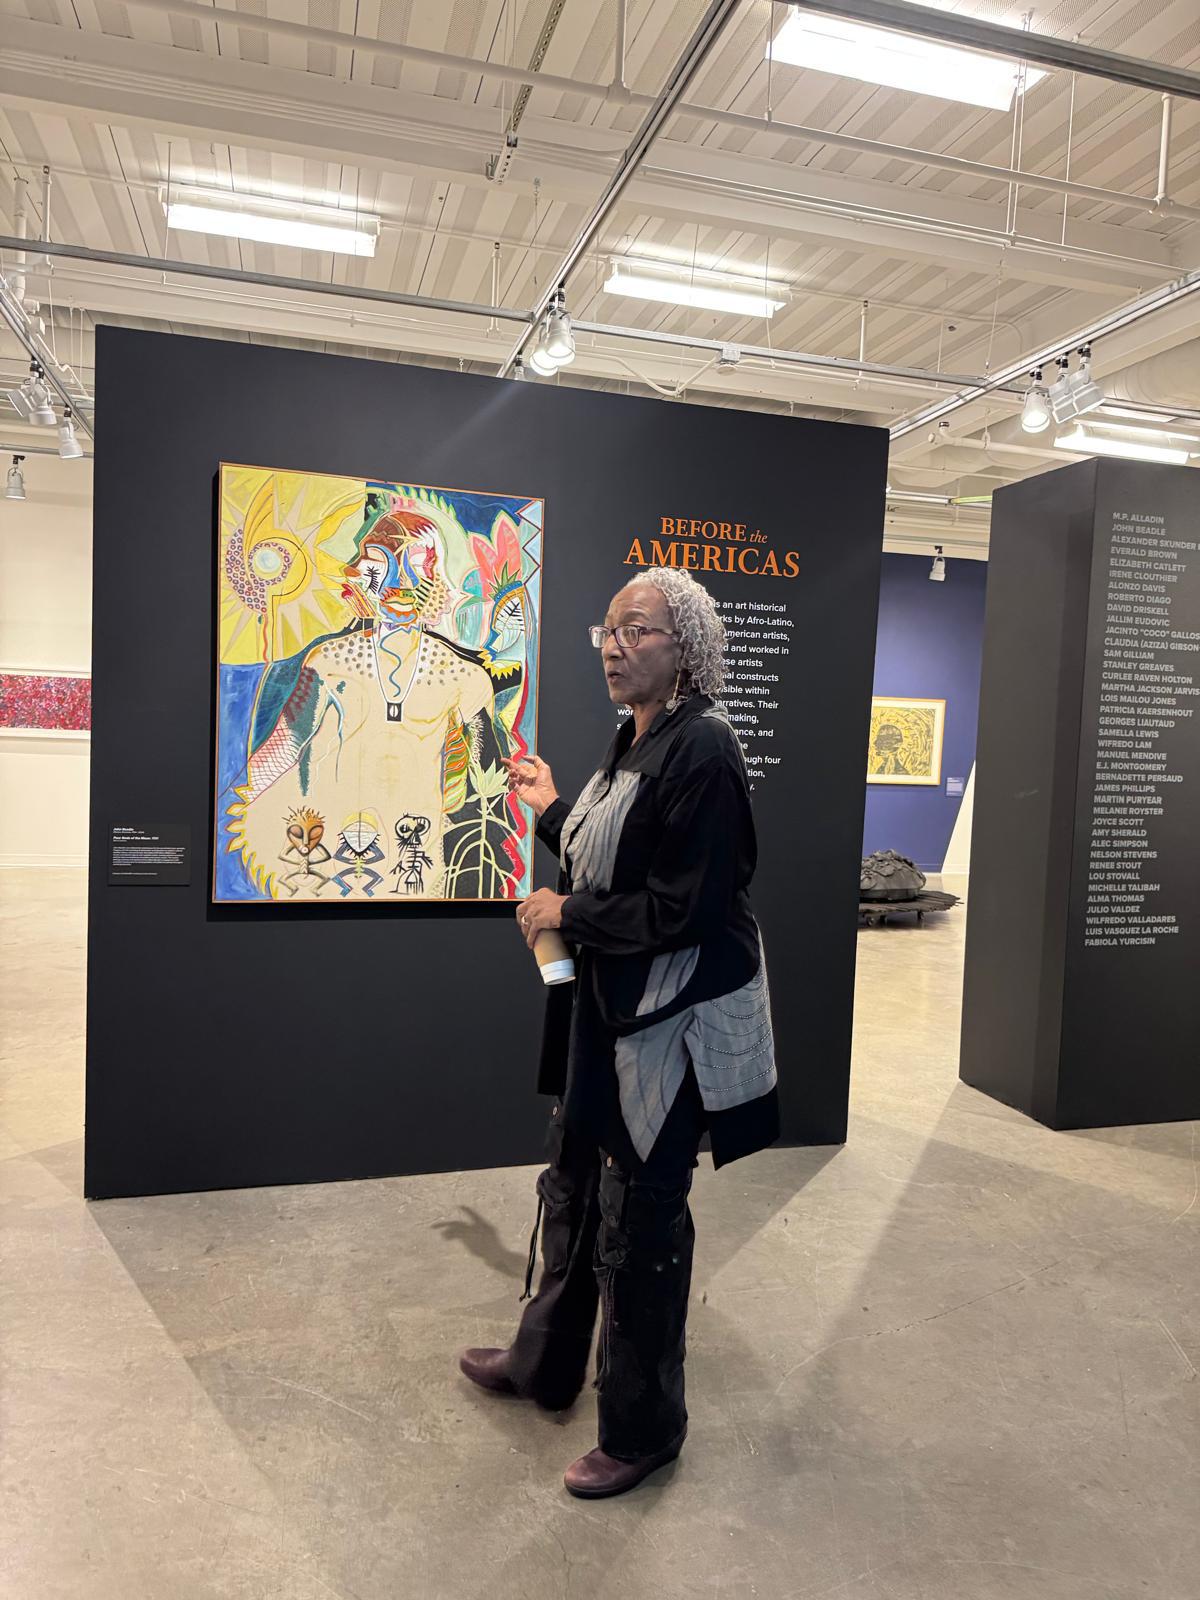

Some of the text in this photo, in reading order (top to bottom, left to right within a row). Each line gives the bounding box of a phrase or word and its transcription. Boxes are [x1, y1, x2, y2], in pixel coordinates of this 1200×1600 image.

[1130, 514, 1164, 524] ALLADIN
[660, 516, 768, 544] BEFORE the
[1112, 524, 1167, 536] JOHN BEADLE
[1111, 535, 1158, 546] ALEXANDER
[1110, 546, 1178, 560] EVERALD BROWN
[623, 538, 800, 578] AMERICAS
[1110, 558, 1187, 572] ELIZABETH CATLETT
[1134, 572, 1178, 582] CLOUTHIER
[1108, 582, 1166, 593] ALONZO DAVIS
[1107, 592, 1172, 604] ROBERTO DIAGO
[749, 604, 786, 612] historical
[1106, 603, 1169, 615] DAVID DRISKELL
[734, 616, 745, 625] by
[746, 616, 794, 628] Afro-Latino,
[1134, 617, 1170, 626] EUDOVIC
[1105, 626, 1138, 636] JACINTO
[762, 632, 790, 641] artists,
[1104, 638, 1139, 647] CLAUDIA
[730, 645, 747, 653] and
[748, 646, 779, 654] worked
[781, 647, 789, 655] in
[1103, 649, 1154, 659] SAM GILLIAM
[737, 659, 763, 667] artists
[1102, 660, 1175, 672] STANLEY GREAVES
[736, 672, 779, 682] constructs
[1102, 672, 1193, 684] CURLEE RAVEN HOLTON
[745, 686, 770, 695] within
[1101, 683, 1135, 692] MARTHA
[1136, 685, 1172, 694] JACKSON
[1100, 694, 1176, 705] LOIS MAILOU JONES
[757, 700, 779, 709] Their
[1099, 705, 1135, 714] PATRICIA
[1099, 716, 1175, 728] GEORGES LIAUTAUD
[757, 729, 773, 737] and
[1098, 728, 1159, 738] SAMELLA LEWIS
[1097, 739, 1152, 749] WIFREDO LAM
[764, 756, 781, 764] four
[1096, 751, 1167, 760] MANUEL MENDIVE
[1110, 762, 1167, 771] MONTGOMERY
[1095, 773, 1183, 782] BERNADETTE PERSAUD
[1094, 784, 1156, 793] JAMES PHILLIPS
[1094, 795, 1162, 804] MARTIN PURYEAR
[1093, 807, 1127, 815] MELANIE
[1118, 818, 1144, 826] SCOTT
[1111, 829, 1147, 837] SHERALD
[1112, 840, 1148, 848] SIMPSON
[1106, 872, 1140, 880] STOVALL
[1088, 884, 1126, 892] MICHELLE
[1087, 895, 1110, 903] ALMA
[1086, 905, 1140, 914] JULIO VALDEZ
[1127, 915, 1176, 924] VALLADARES
[1104, 927, 1140, 935] VASQUEZ
[1141, 926, 1151, 934] LA
[1152, 926, 1179, 934] ROCHE
[1085, 938, 1118, 946] FABIOLA
